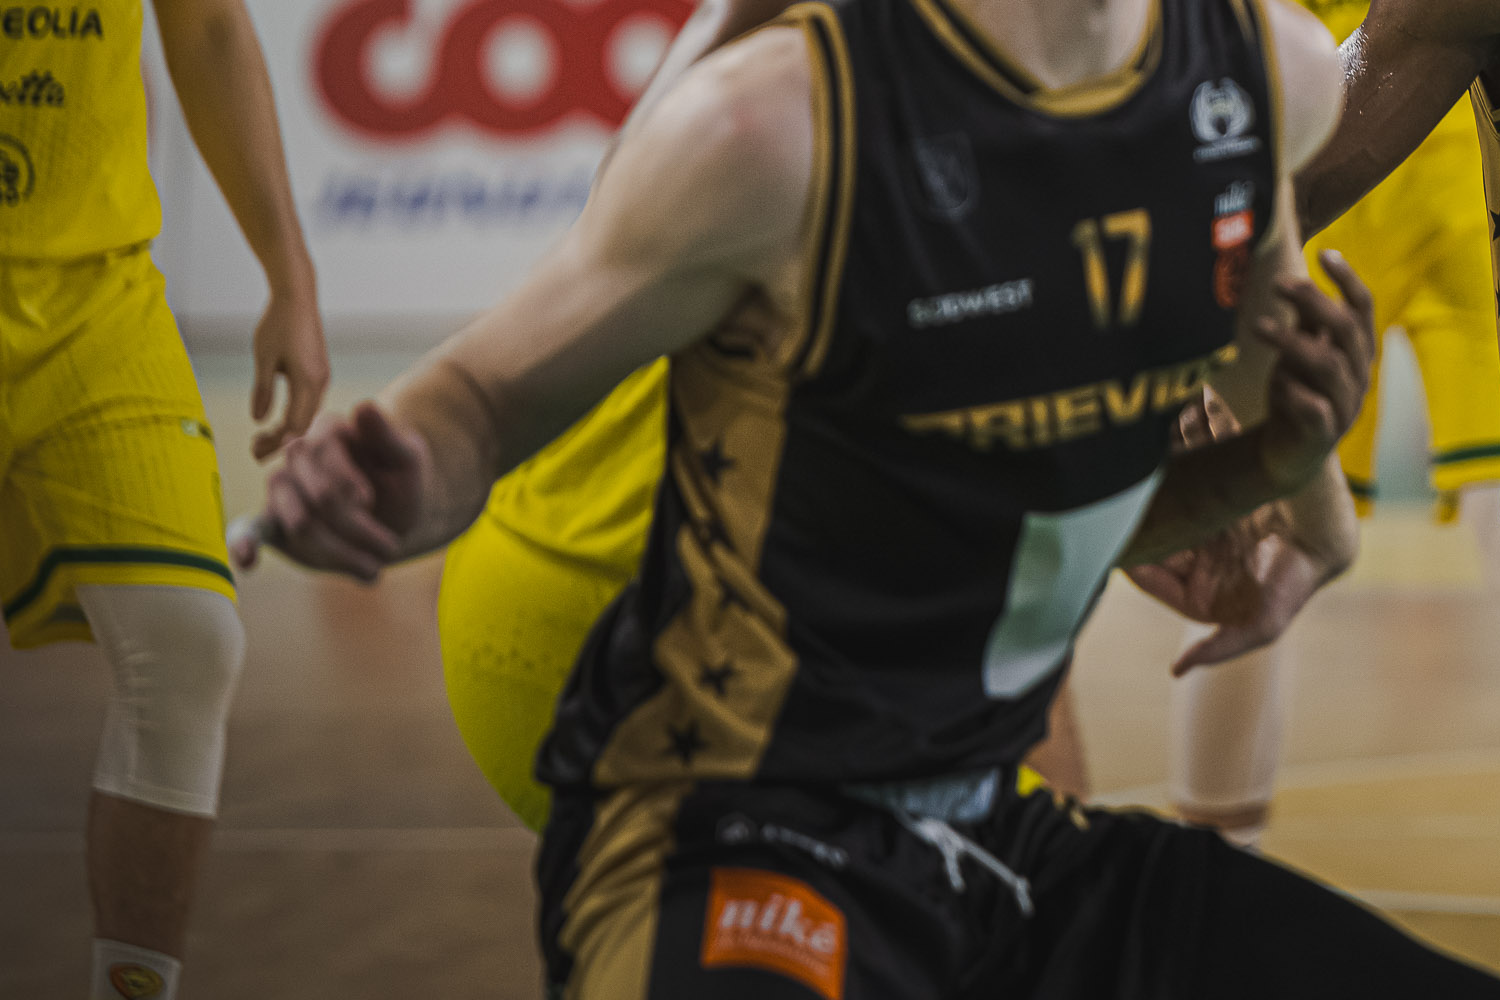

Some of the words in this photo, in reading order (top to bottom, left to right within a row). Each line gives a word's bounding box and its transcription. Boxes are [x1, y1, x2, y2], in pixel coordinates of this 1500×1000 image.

[2, 6, 104, 40] EOLIA
[1072, 207, 1152, 329] 17
[900, 344, 1240, 452] RIEVID
